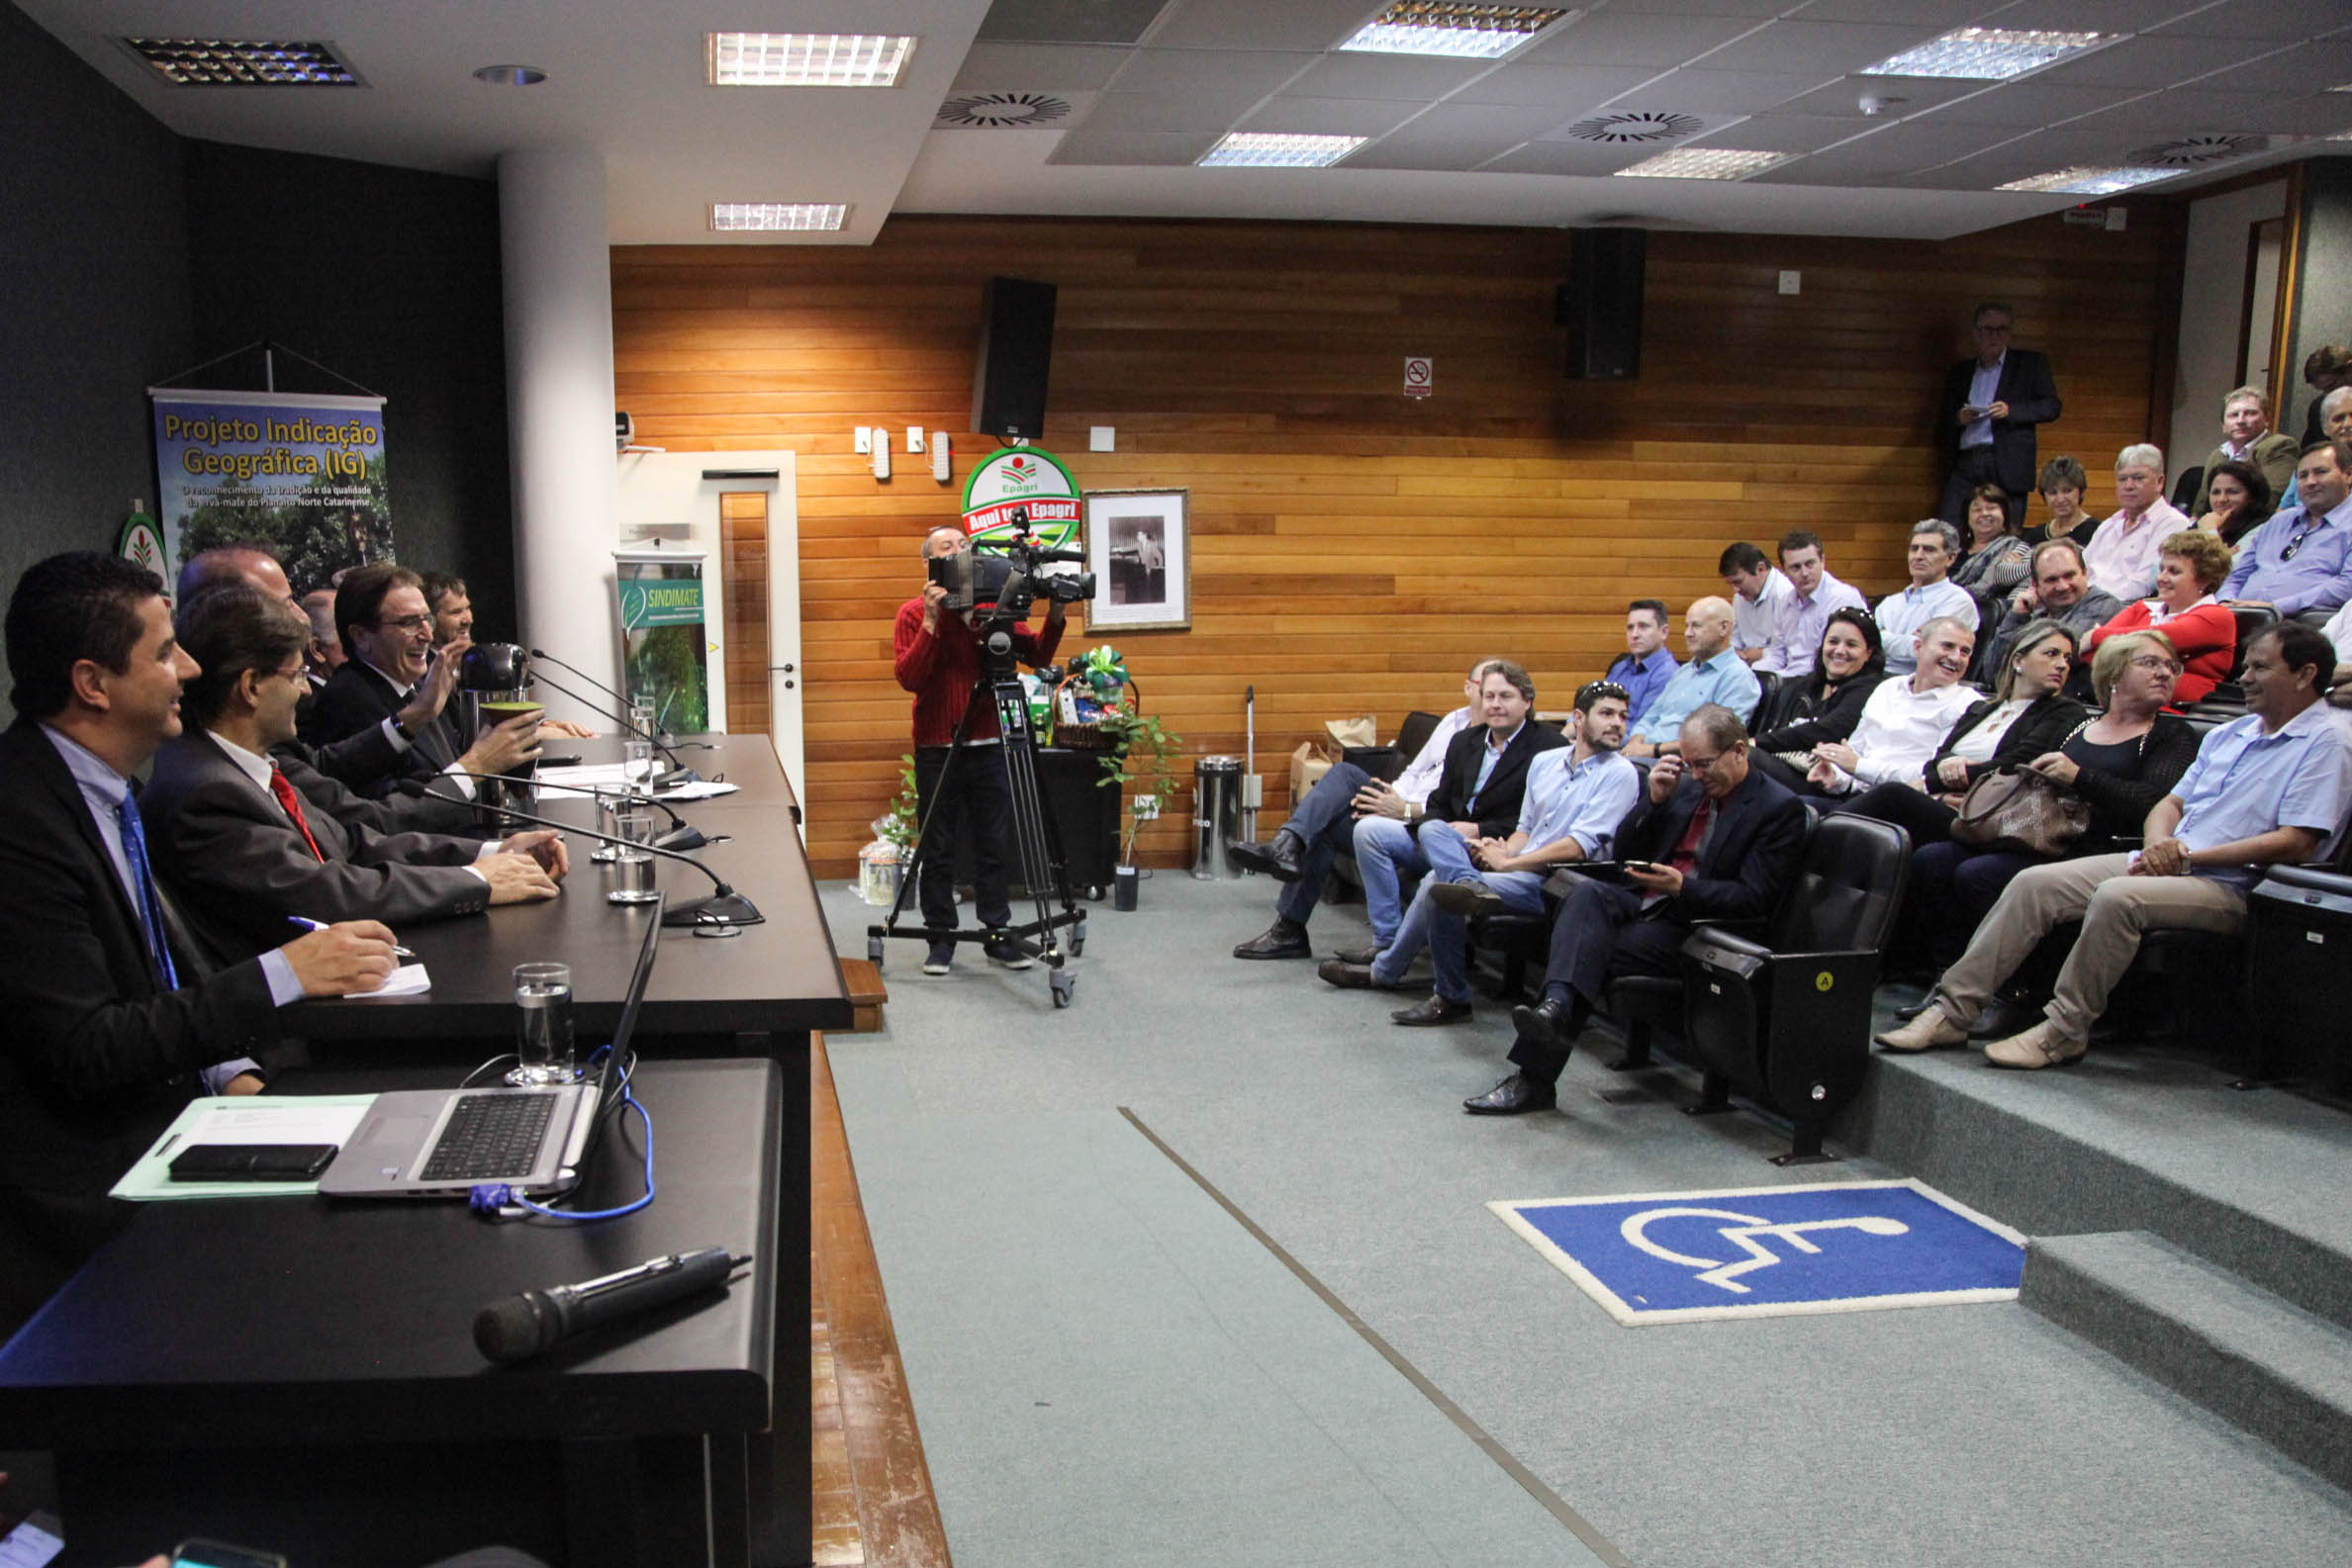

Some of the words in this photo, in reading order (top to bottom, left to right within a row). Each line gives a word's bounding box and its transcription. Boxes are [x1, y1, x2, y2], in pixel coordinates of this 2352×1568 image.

[164, 415, 259, 446] Projeto
[266, 417, 378, 449] Indicação
[183, 447, 318, 480] Geográfica
[325, 448, 367, 481] (IG)
[322, 485, 331, 495] da
[333, 485, 371, 497] qualidade
[1002, 483, 1037, 494] Epagri
[298, 498, 322, 507] Norte
[970, 508, 1000, 531] Aqui
[1031, 503, 1076, 517] Epagri
[648, 588, 699, 607] SINDIMATE
[1822, 976, 1830, 986] A
